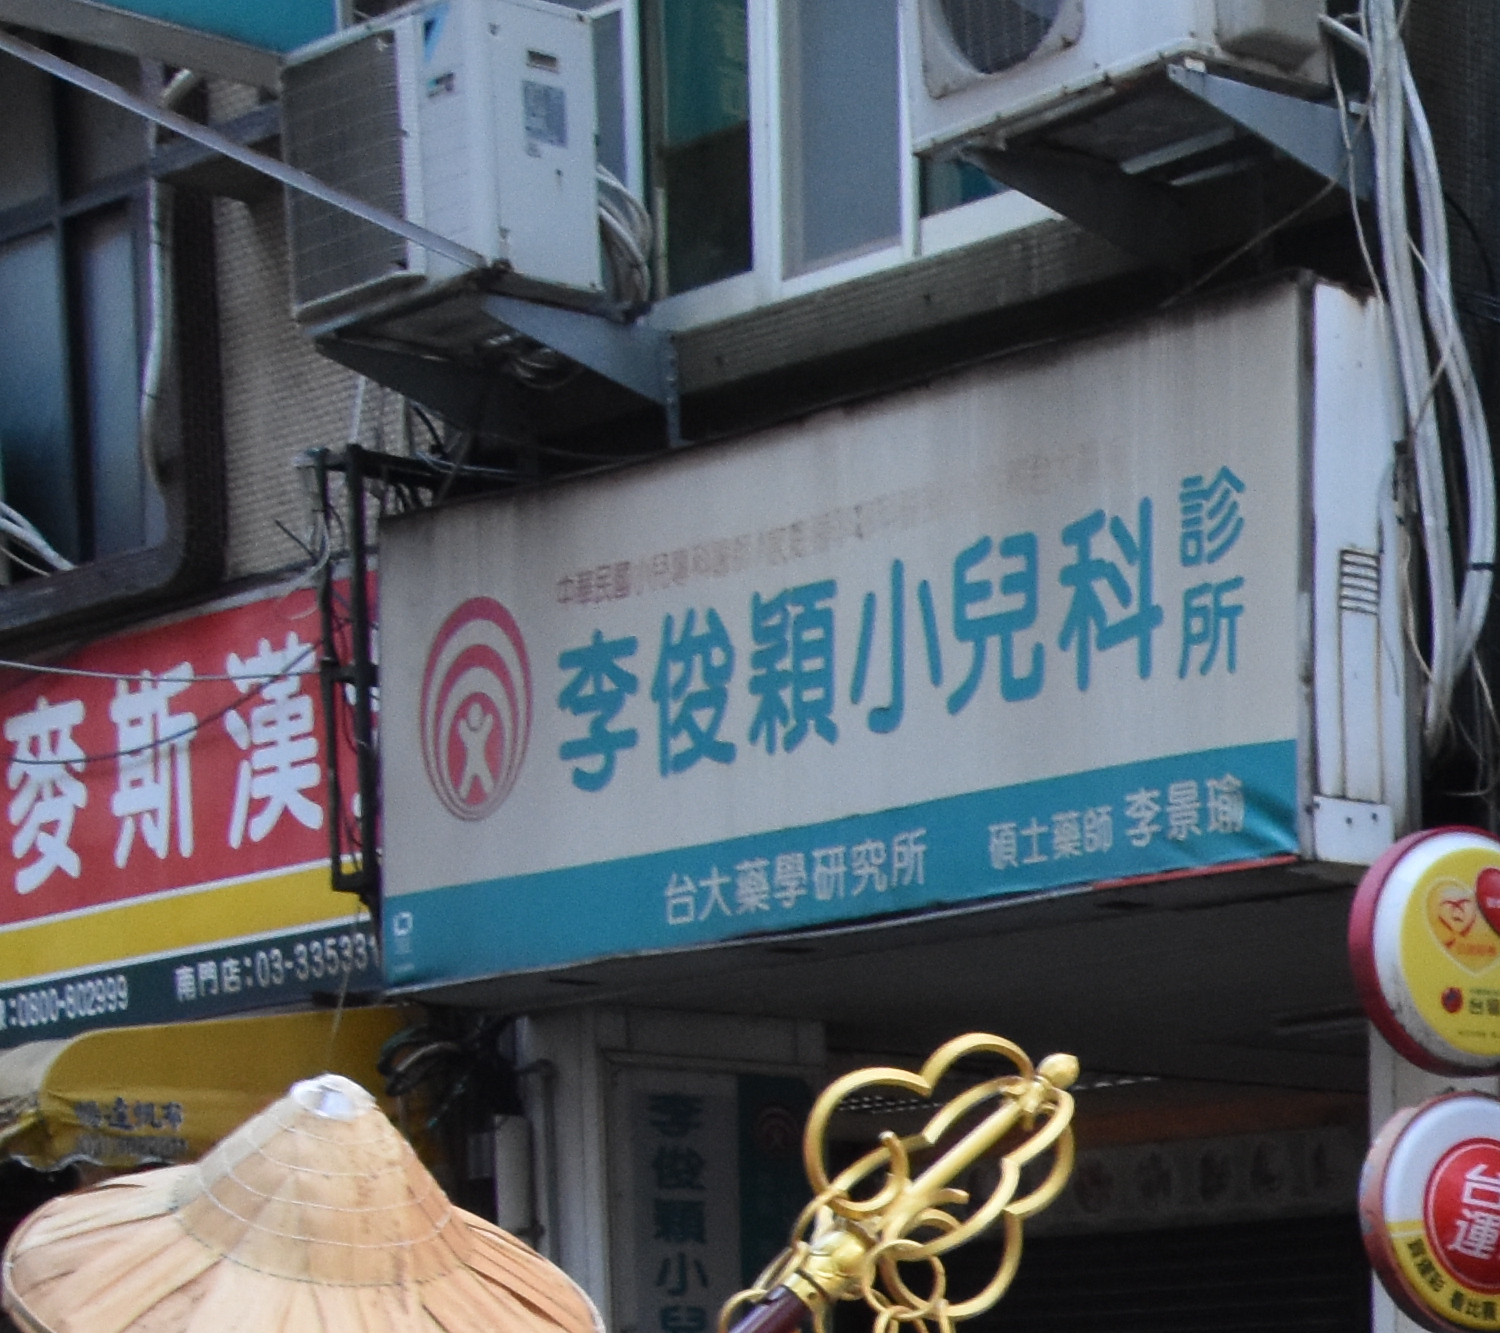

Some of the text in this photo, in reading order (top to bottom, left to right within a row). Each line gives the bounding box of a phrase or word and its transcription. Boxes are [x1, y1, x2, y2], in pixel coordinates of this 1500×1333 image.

[1179, 464, 1247, 681] 診所
[4, 630, 380, 895] 麥斯漢
[663, 828, 929, 928] 台大藥學研究所
